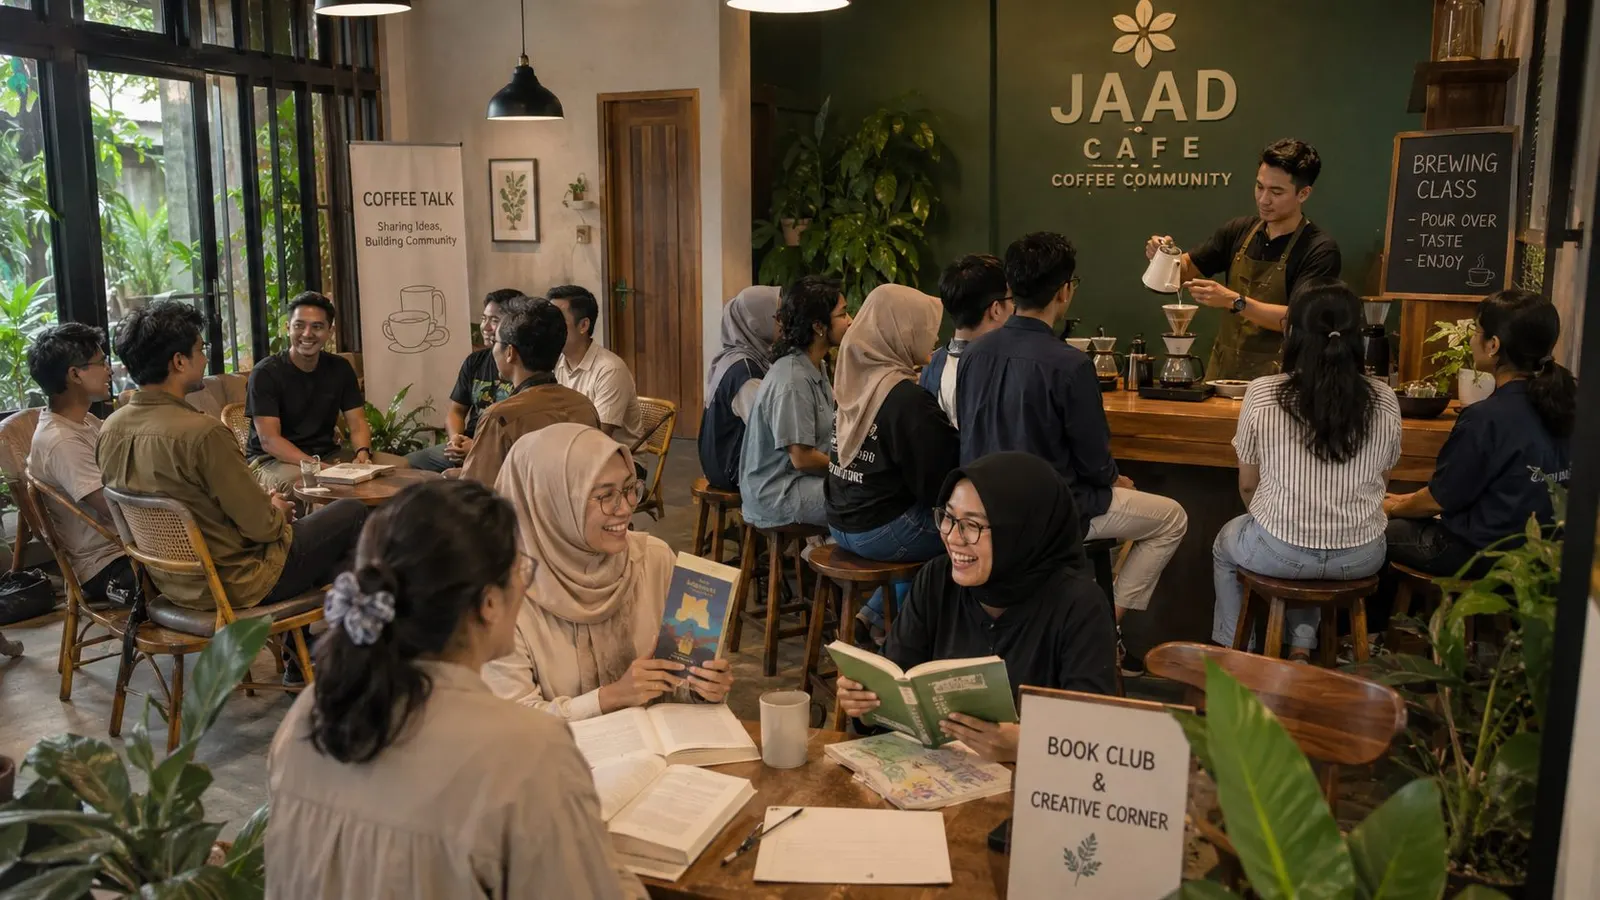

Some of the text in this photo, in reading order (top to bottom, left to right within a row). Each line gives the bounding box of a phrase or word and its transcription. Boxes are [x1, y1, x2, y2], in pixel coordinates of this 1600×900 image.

[1050, 69, 1237, 124] JAAD
[1083, 137, 1199, 159] CAFE
[1413, 153, 1498, 174] BREWING
[1052, 172, 1232, 187] COFFEE COMMUNITY
[1417, 179, 1477, 199] CLASS
[363, 191, 455, 206] COFFEE TALK
[377, 221, 442, 233] Sharing Ideas,
[1421, 212, 1456, 227] POUR
[1461, 214, 1497, 228] OVER
[365, 235, 457, 248] Building Community
[1420, 234, 1463, 248] TASTE
[1417, 254, 1464, 270] ENJOY
[1047, 736, 1155, 771] BOOK CLUB
[1092, 772, 1106, 793] &
[1031, 791, 1168, 831] CREATIVE CORNER
